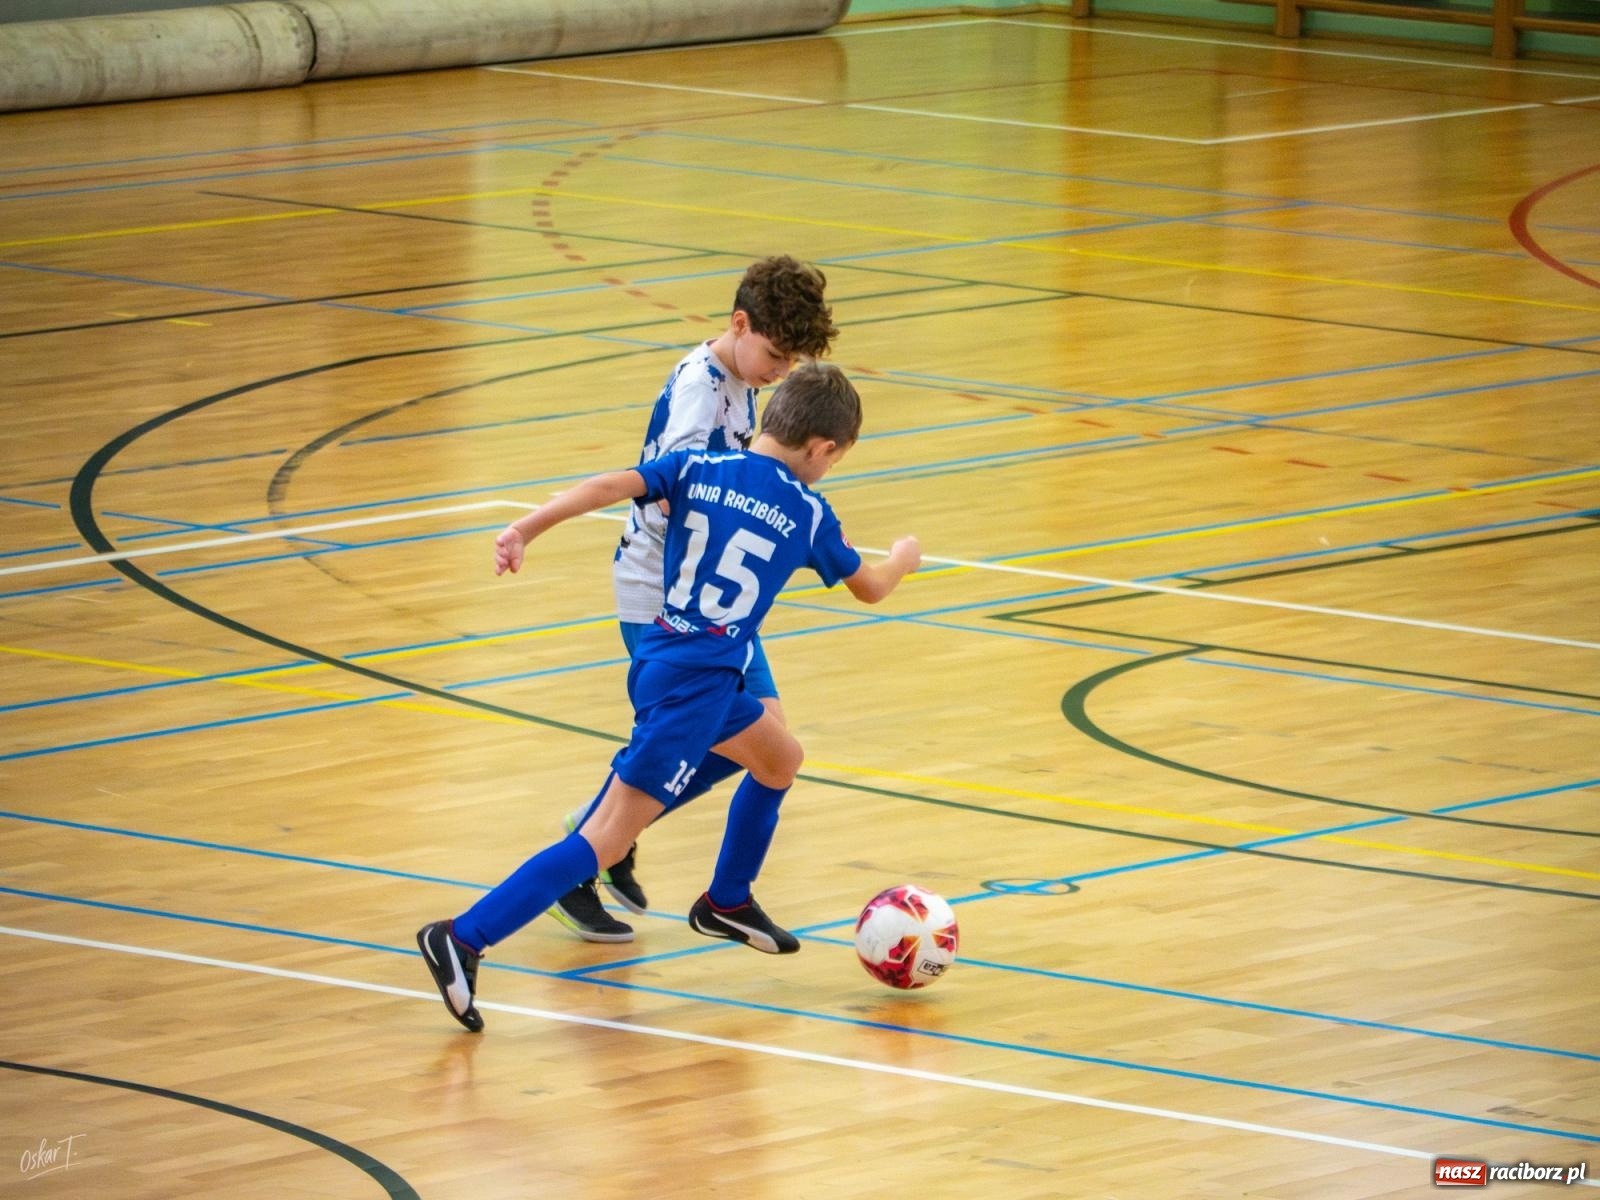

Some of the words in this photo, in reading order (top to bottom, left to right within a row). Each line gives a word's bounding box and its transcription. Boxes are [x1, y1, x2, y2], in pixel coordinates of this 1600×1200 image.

[687, 483, 721, 504] UNIA
[724, 489, 797, 539] RACIBÓRZ
[666, 510, 777, 626] 15
